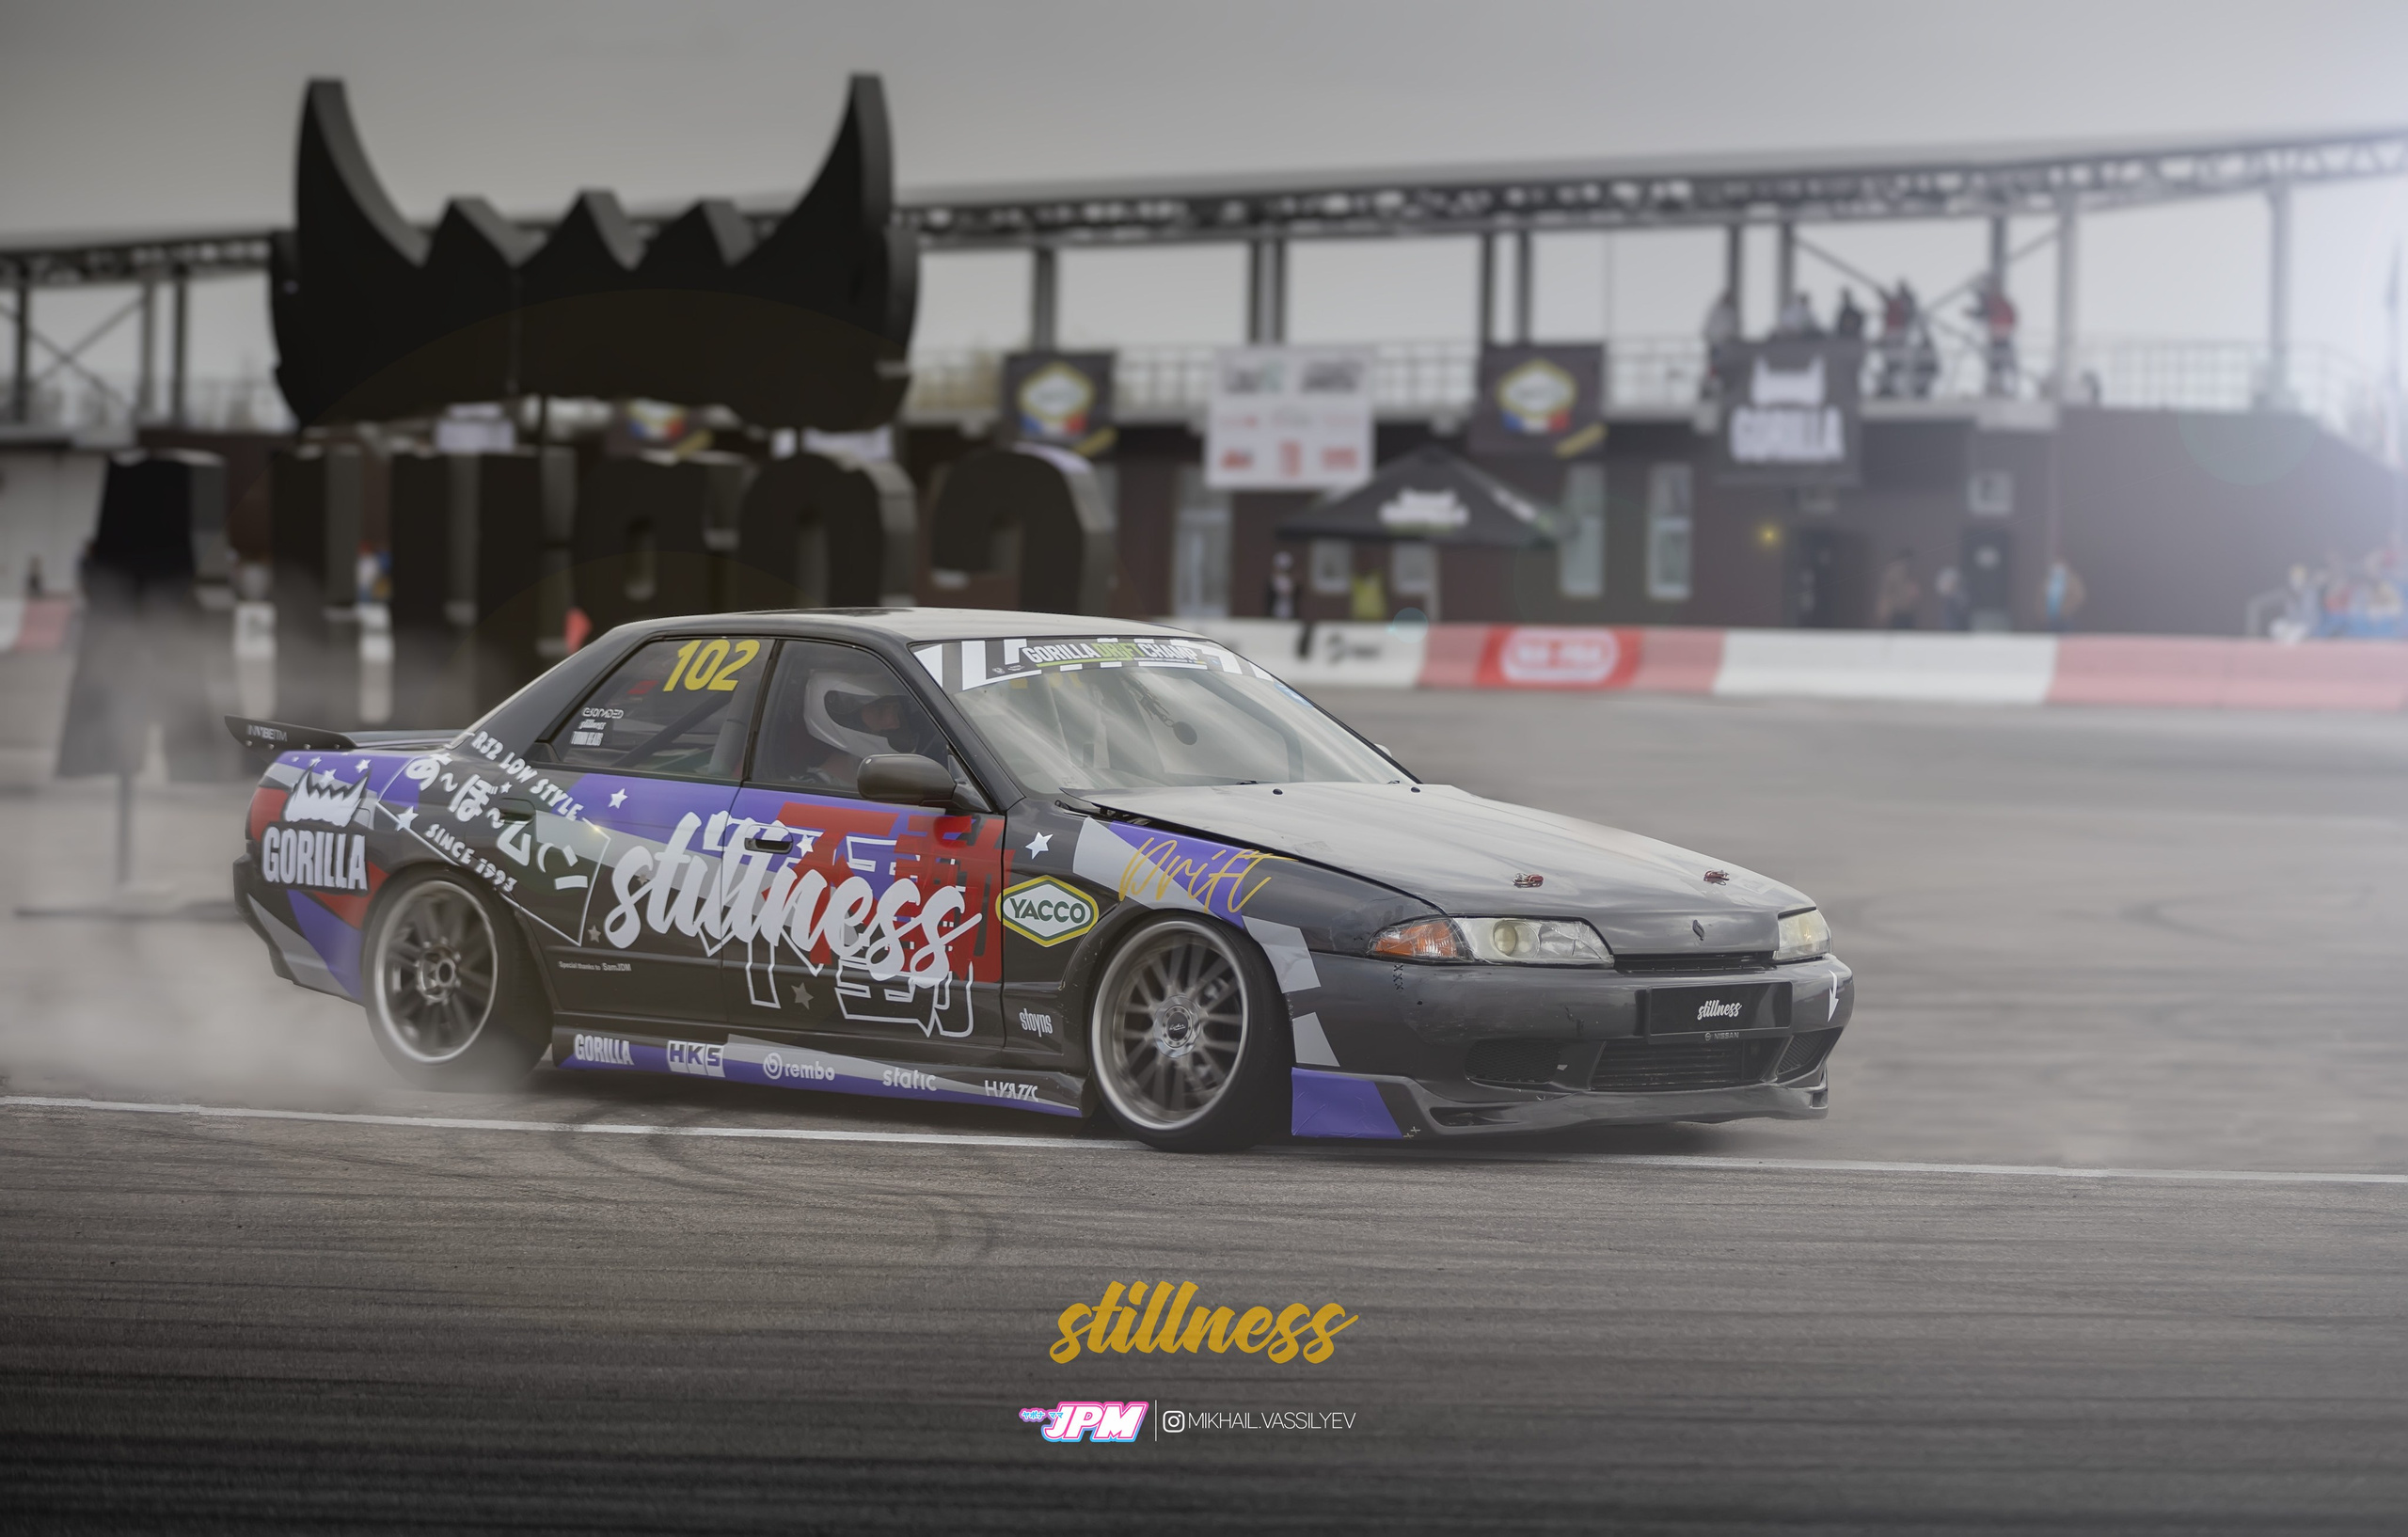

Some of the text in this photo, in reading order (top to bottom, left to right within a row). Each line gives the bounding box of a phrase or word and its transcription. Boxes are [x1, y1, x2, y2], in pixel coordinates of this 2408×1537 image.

[662, 639, 761, 691] 102
[1022, 643, 1101, 663] GORILLA
[1090, 642, 1146, 661] DRIFT
[1137, 642, 1200, 661] CHAMP
[472, 731, 585, 821] R32 LOW STYLE
[262, 825, 369, 892] GORILLA
[425, 823, 518, 894] SINCE 1993
[604, 811, 983, 988] stillness
[1009, 897, 1085, 924] YACCO
[602, 962, 632, 972] SamJDM
[1697, 999, 1743, 1021] stillness
[574, 1033, 635, 1066] GORILLA
[668, 1041, 723, 1071] HKS
[882, 1067, 938, 1092] static
